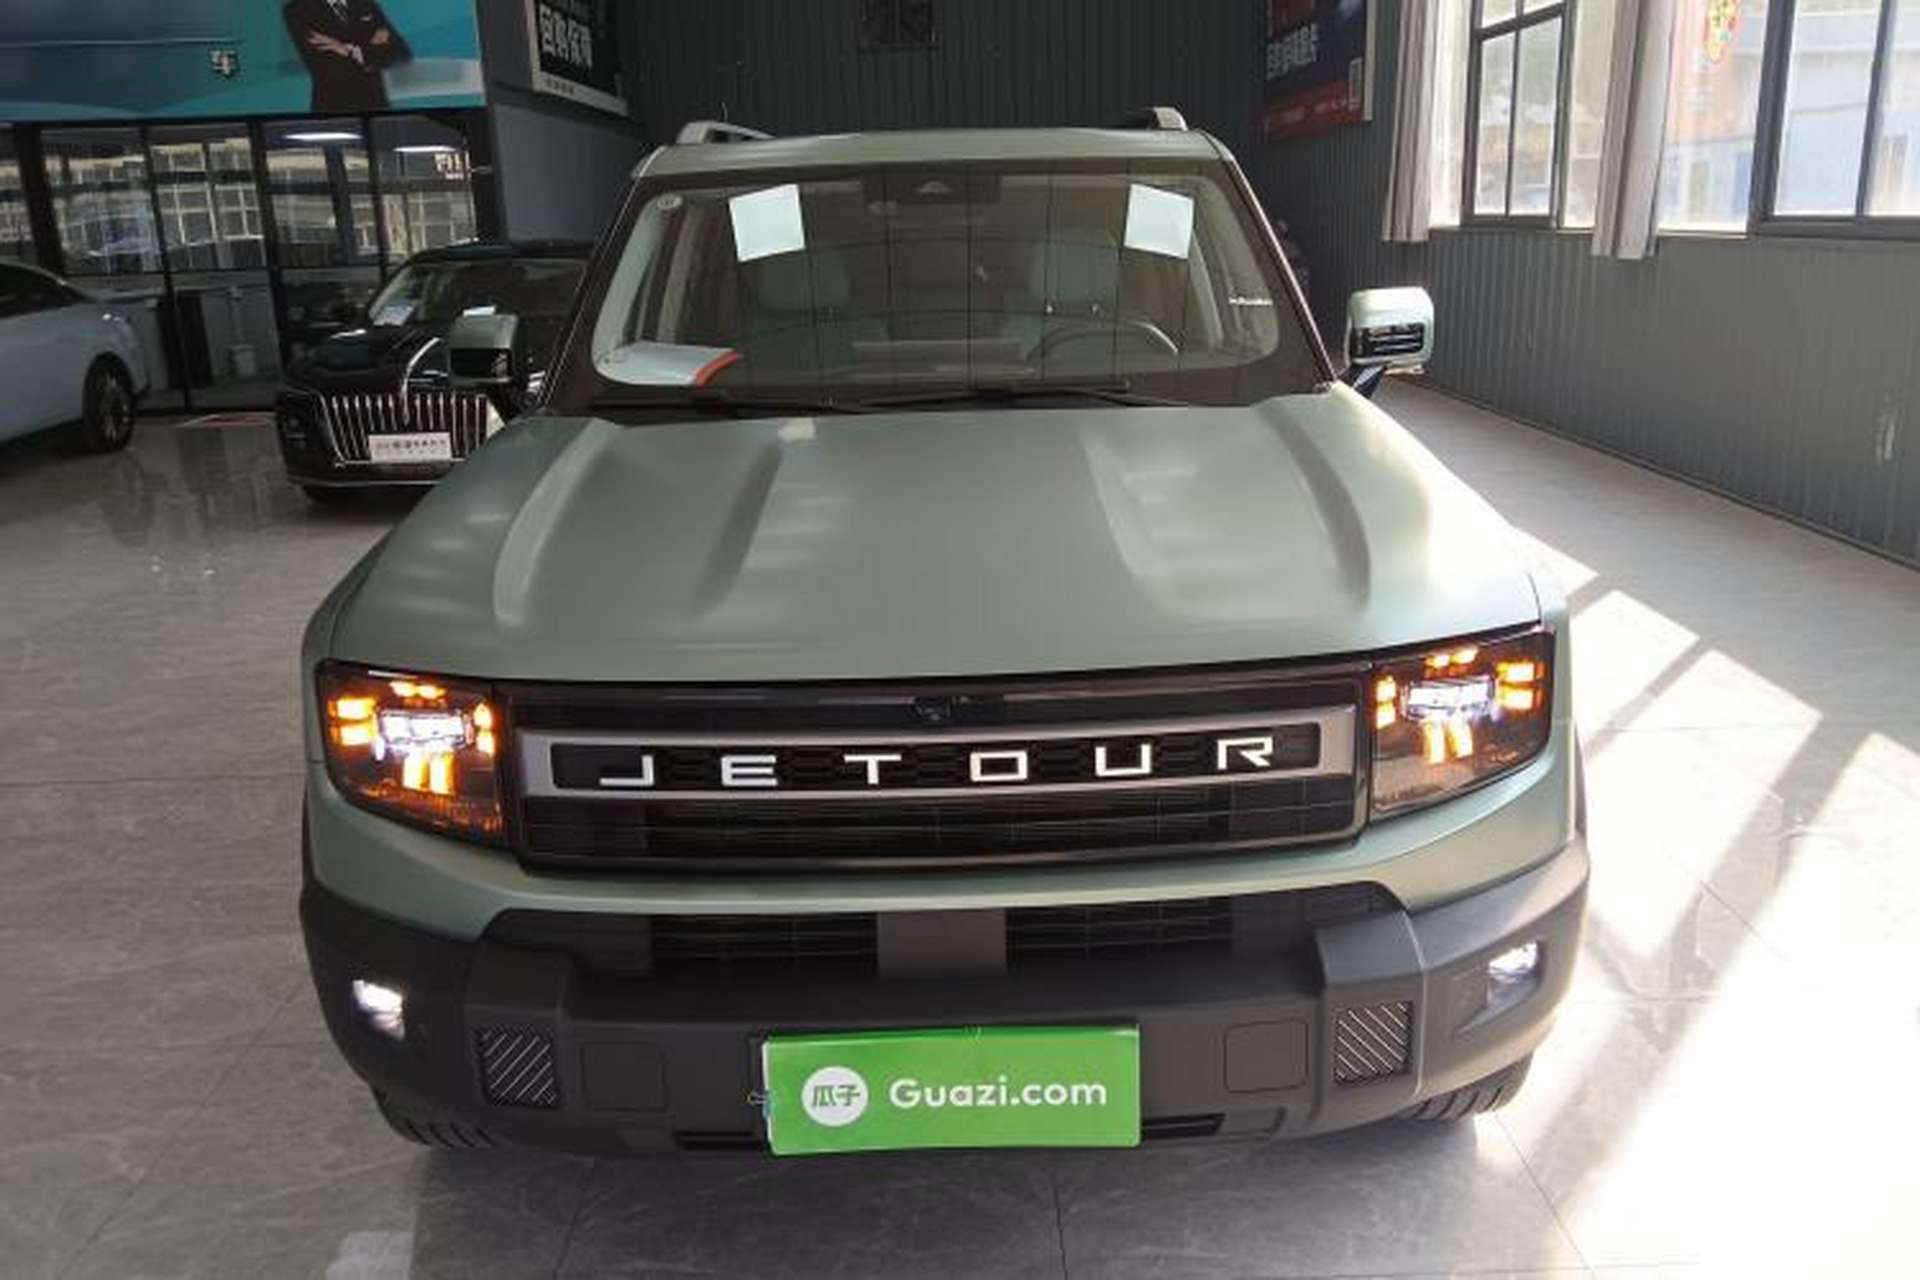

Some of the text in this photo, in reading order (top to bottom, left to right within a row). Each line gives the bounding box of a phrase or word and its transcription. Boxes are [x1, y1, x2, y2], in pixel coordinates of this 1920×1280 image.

[599, 736, 1273, 787] JETOUR
[811, 1083, 861, 1108] 瓜子
[889, 1075, 1107, 1109] Guazi.com
